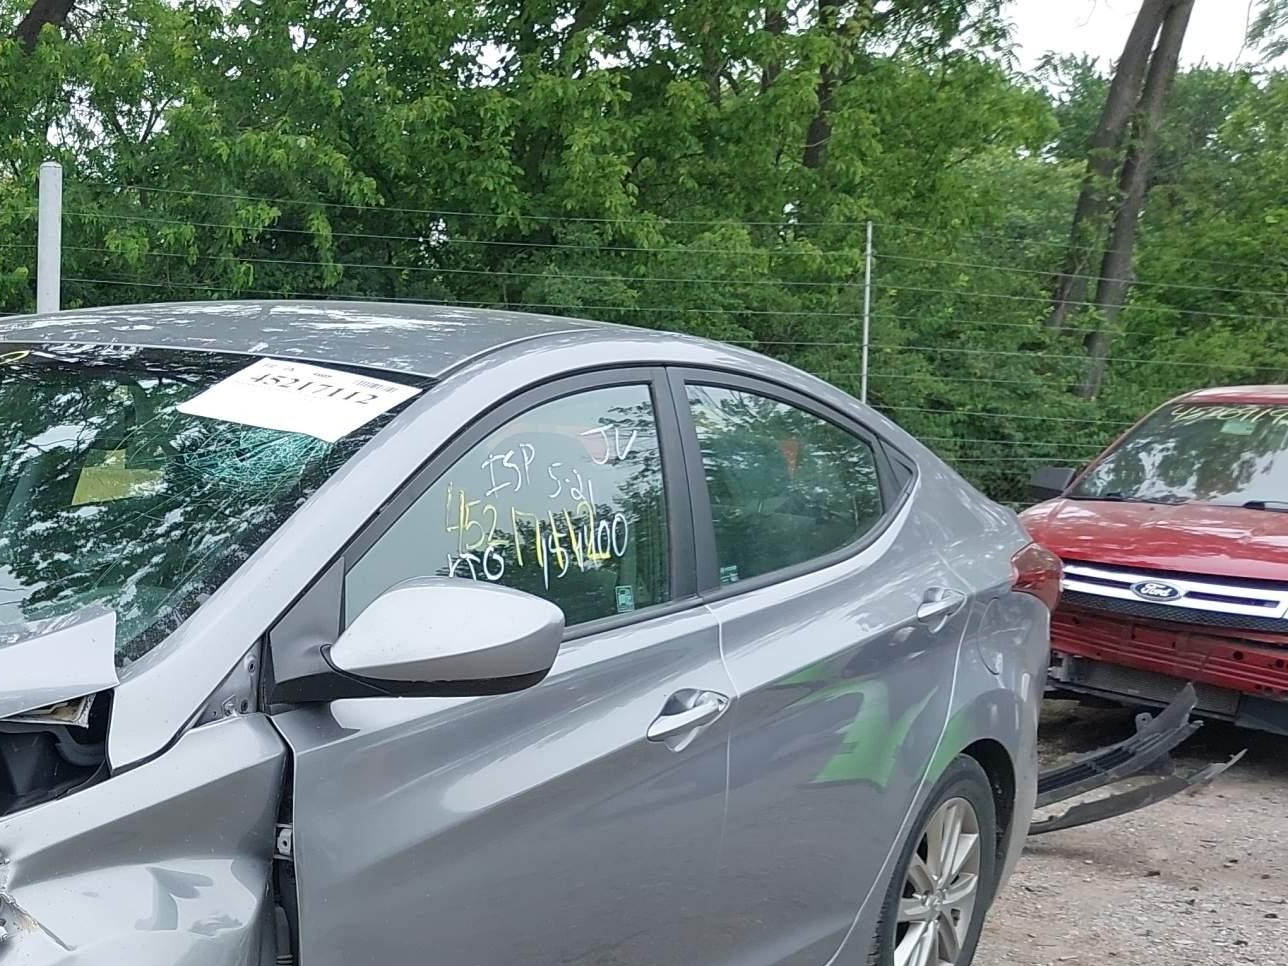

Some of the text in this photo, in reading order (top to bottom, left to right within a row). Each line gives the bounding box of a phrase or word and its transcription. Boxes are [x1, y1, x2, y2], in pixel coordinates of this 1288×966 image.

[251, 373, 379, 404] 45217112
[481, 443, 536, 498] ISP
[1140, 583, 1172, 597] Ford
